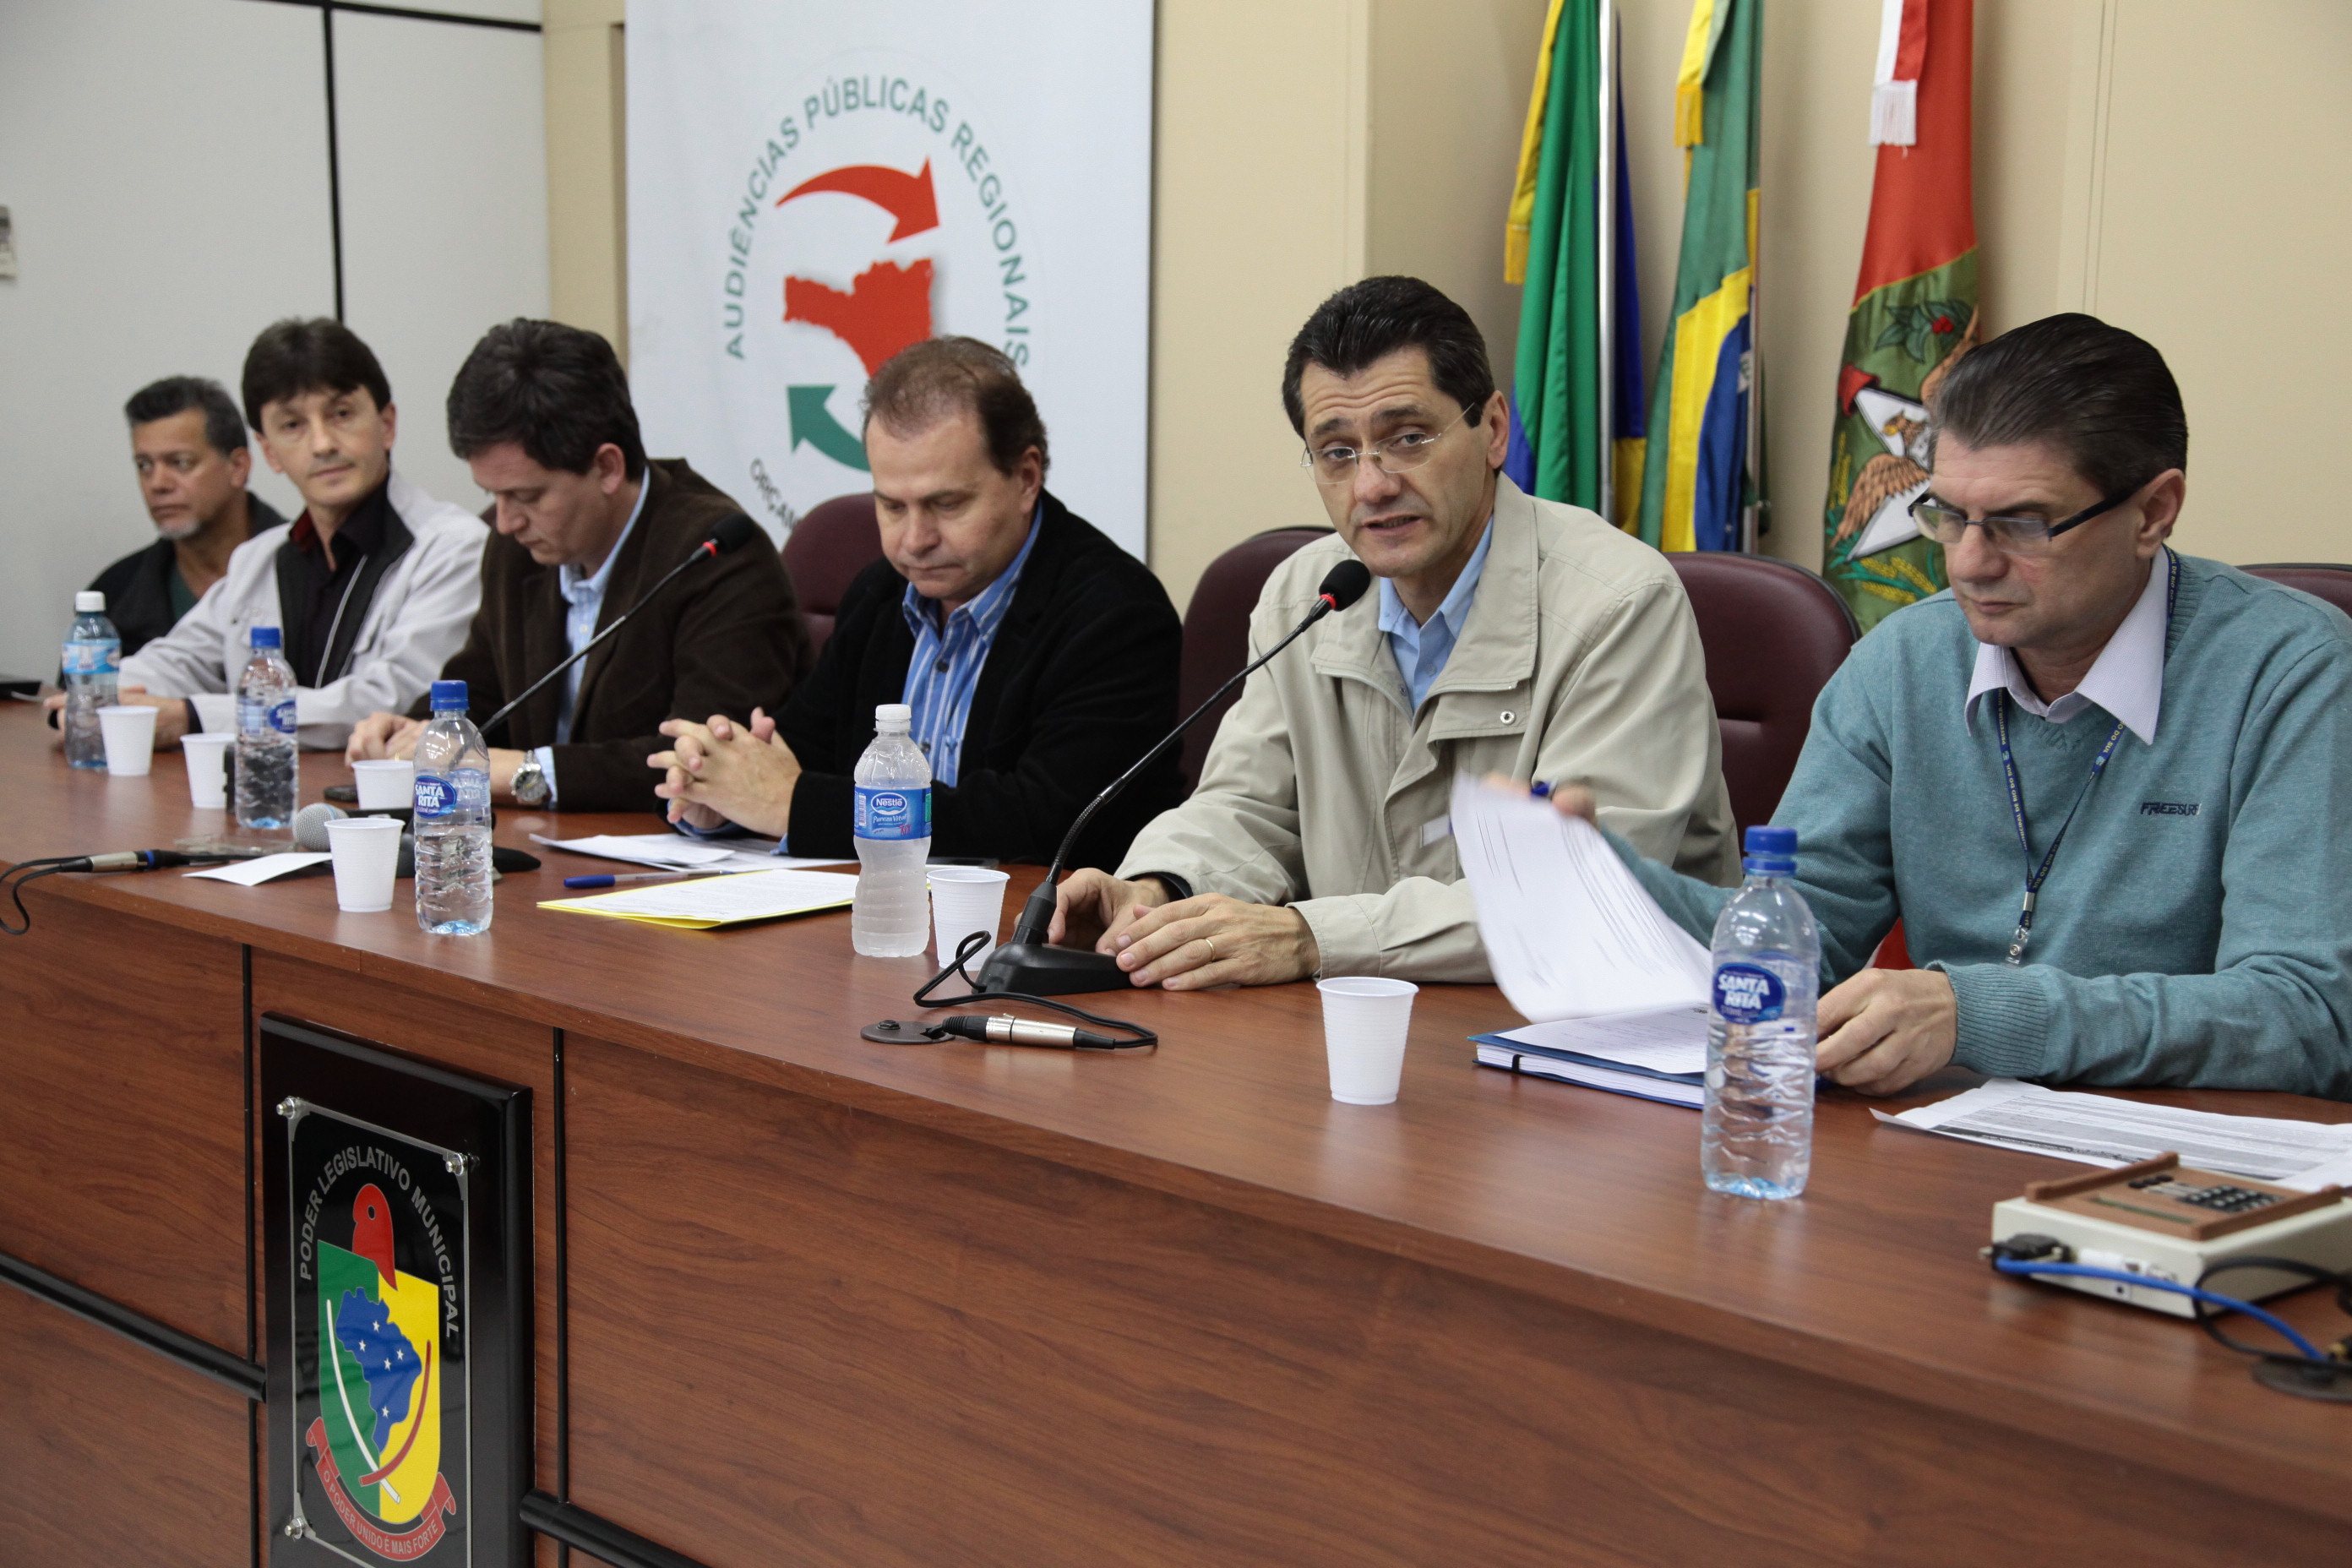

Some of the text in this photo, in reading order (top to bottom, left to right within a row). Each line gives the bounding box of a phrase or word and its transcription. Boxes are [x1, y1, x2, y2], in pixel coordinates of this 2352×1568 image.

[724, 75, 1030, 368] AUDIÊNCIAS PÚBLICAS REGIONAIS
[2110, 730, 2121, 741] DO
[2103, 741, 2114, 753] SUL
[2009, 777, 2016, 788] DO
[415, 784, 445, 798] SANTA
[418, 795, 440, 807] RITA
[876, 798, 903, 807] Nestlé
[1718, 973, 1771, 996] SANTA
[1724, 991, 1762, 1010] RITA
[300, 1146, 459, 1338] PODER LEGISLATIVO MUNICIPAL
[324, 1471, 438, 1554] O PODER UNIDO É MAIS FORTE
